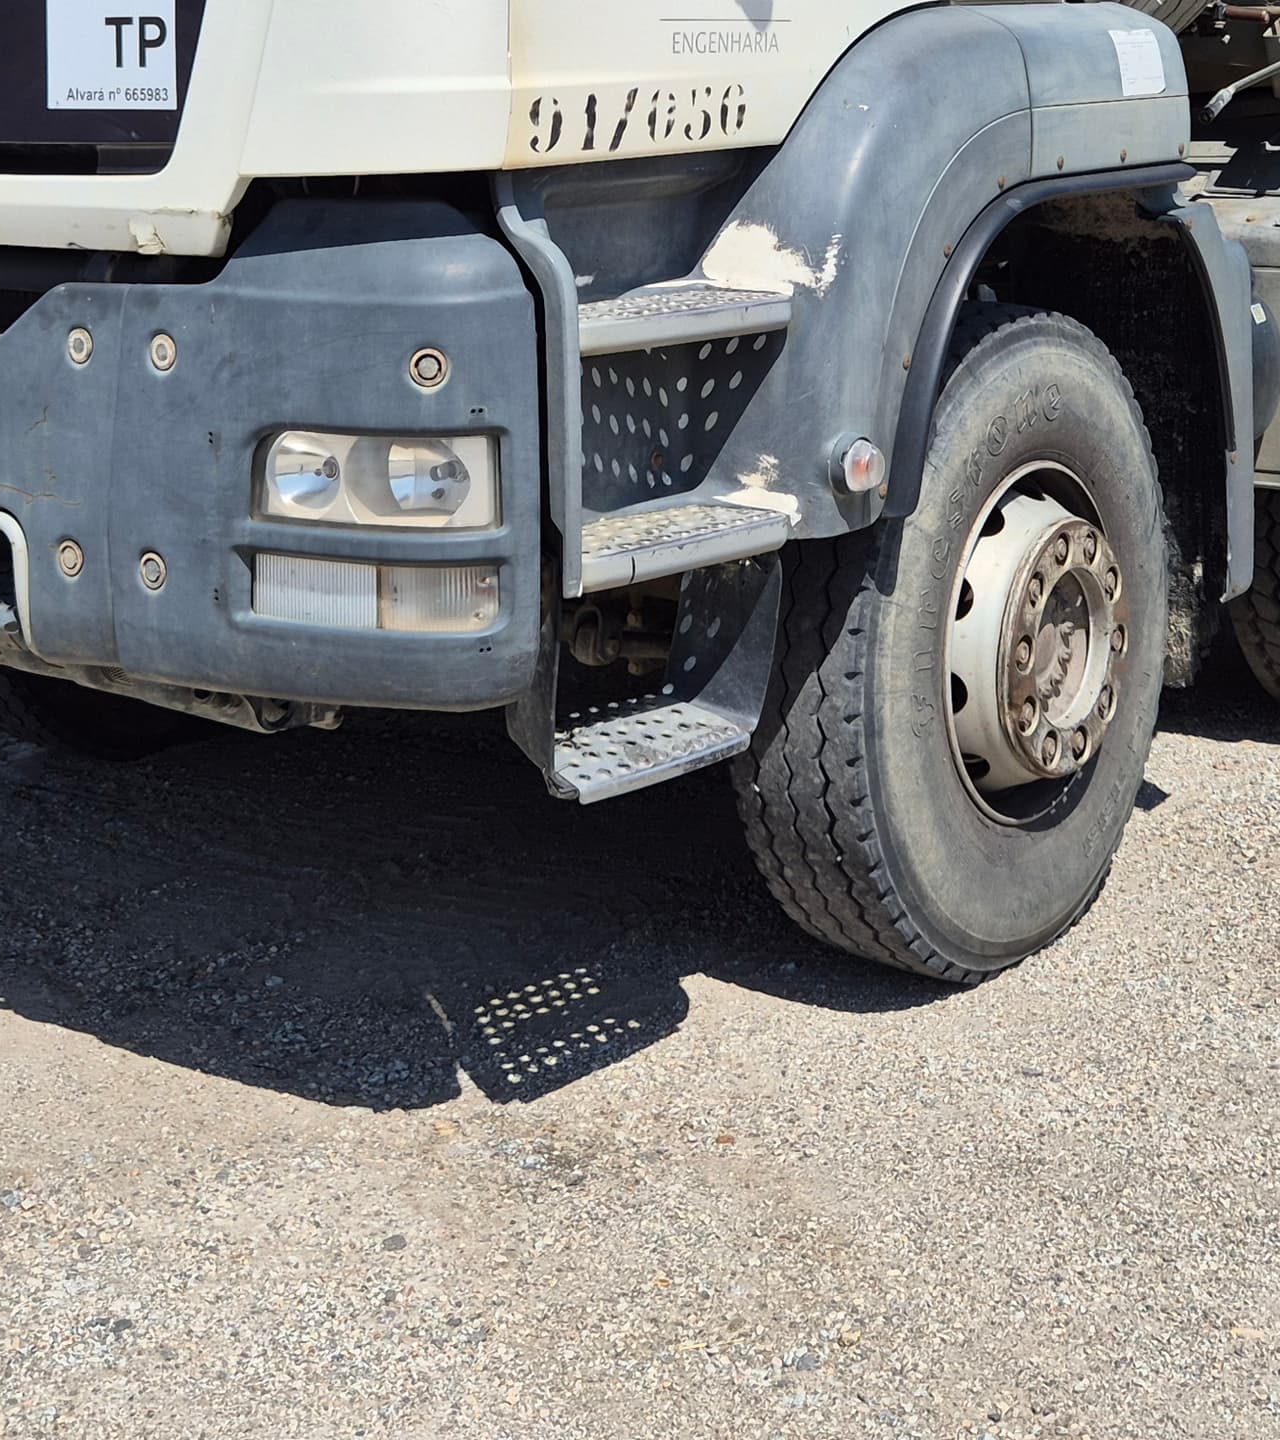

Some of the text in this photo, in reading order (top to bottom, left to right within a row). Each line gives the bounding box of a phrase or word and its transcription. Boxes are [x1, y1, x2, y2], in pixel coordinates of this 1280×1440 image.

[104, 16, 167, 68] TP
[672, 31, 780, 54] ENGENHARIA
[66, 87, 105, 102] Alvará
[124, 87, 169, 102] 665983
